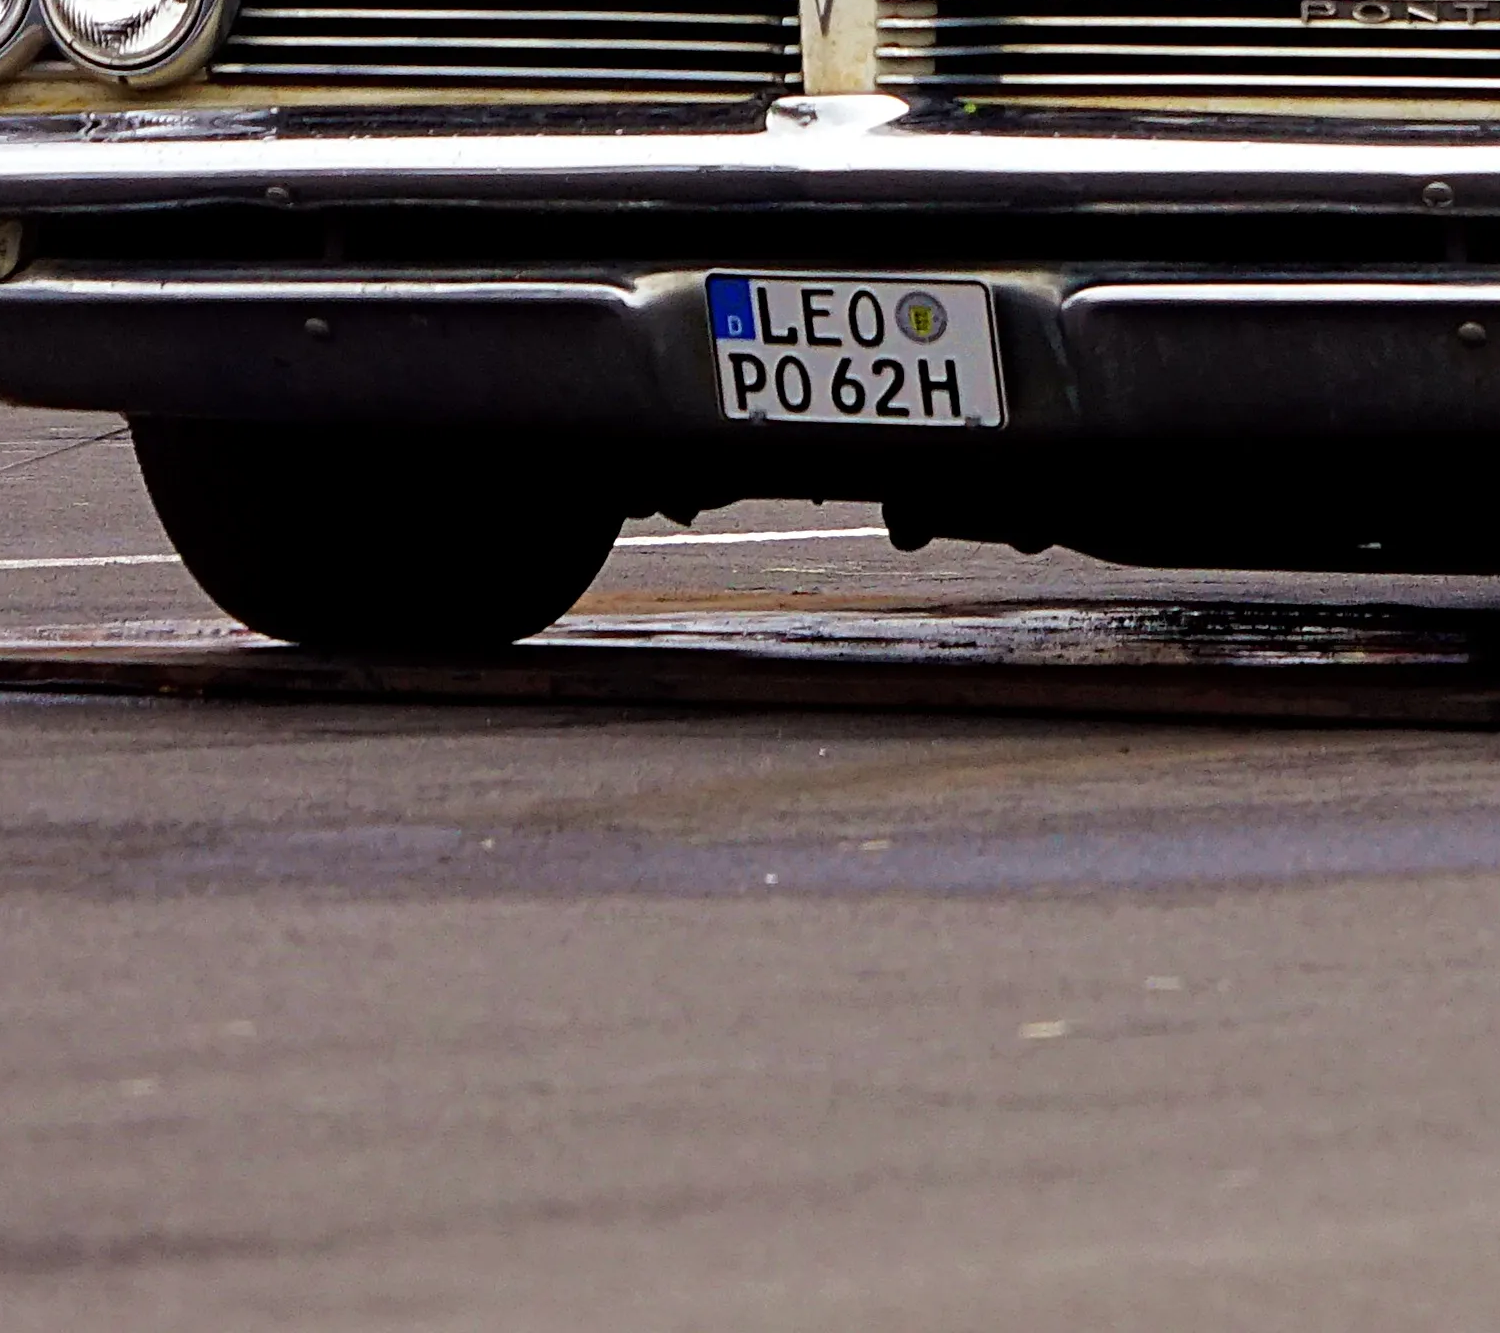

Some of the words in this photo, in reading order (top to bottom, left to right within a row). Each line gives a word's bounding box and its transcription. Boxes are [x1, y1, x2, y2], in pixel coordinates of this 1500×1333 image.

[727, 315, 743, 335] D
[757, 287, 885, 348] LEO
[728, 353, 812, 413] PO
[831, 357, 961, 417] 62H
